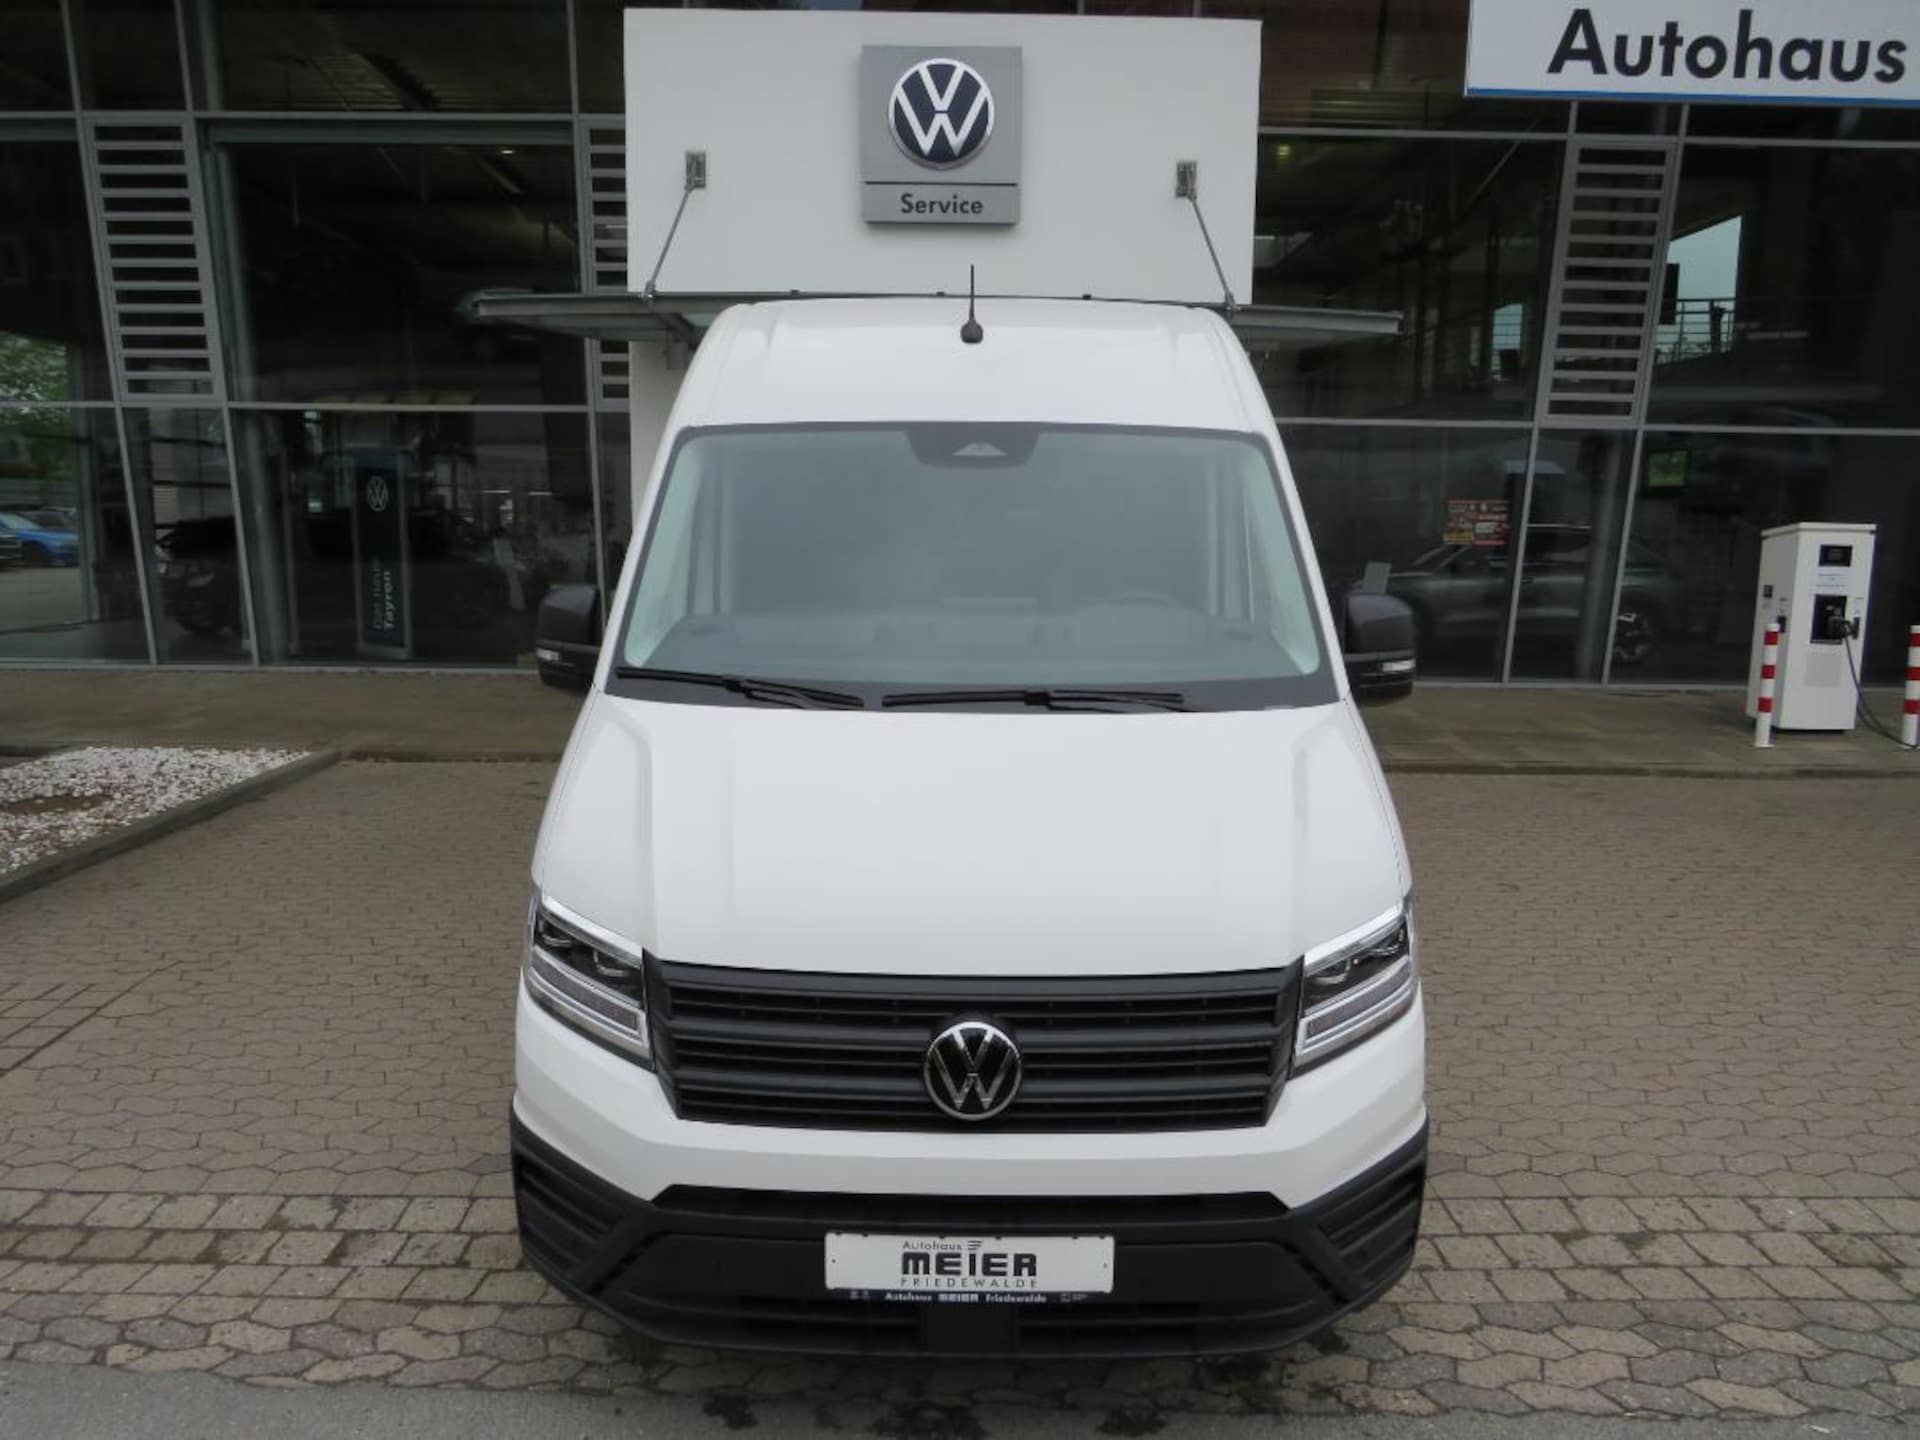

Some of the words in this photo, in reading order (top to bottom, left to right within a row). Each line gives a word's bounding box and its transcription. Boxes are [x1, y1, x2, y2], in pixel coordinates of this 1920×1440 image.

[1546, 8, 1908, 83] Autohaus
[889, 58, 994, 171] VW
[901, 193, 983, 214] Service
[384, 571, 394, 630] Tayron
[924, 1022, 1022, 1121] VW
[902, 1241, 962, 1251] Autohaus
[902, 1252, 1037, 1276] MEIER
[901, 1278, 1038, 1289] FRIEDEWALDE
[885, 1292, 932, 1302] Autohaus
